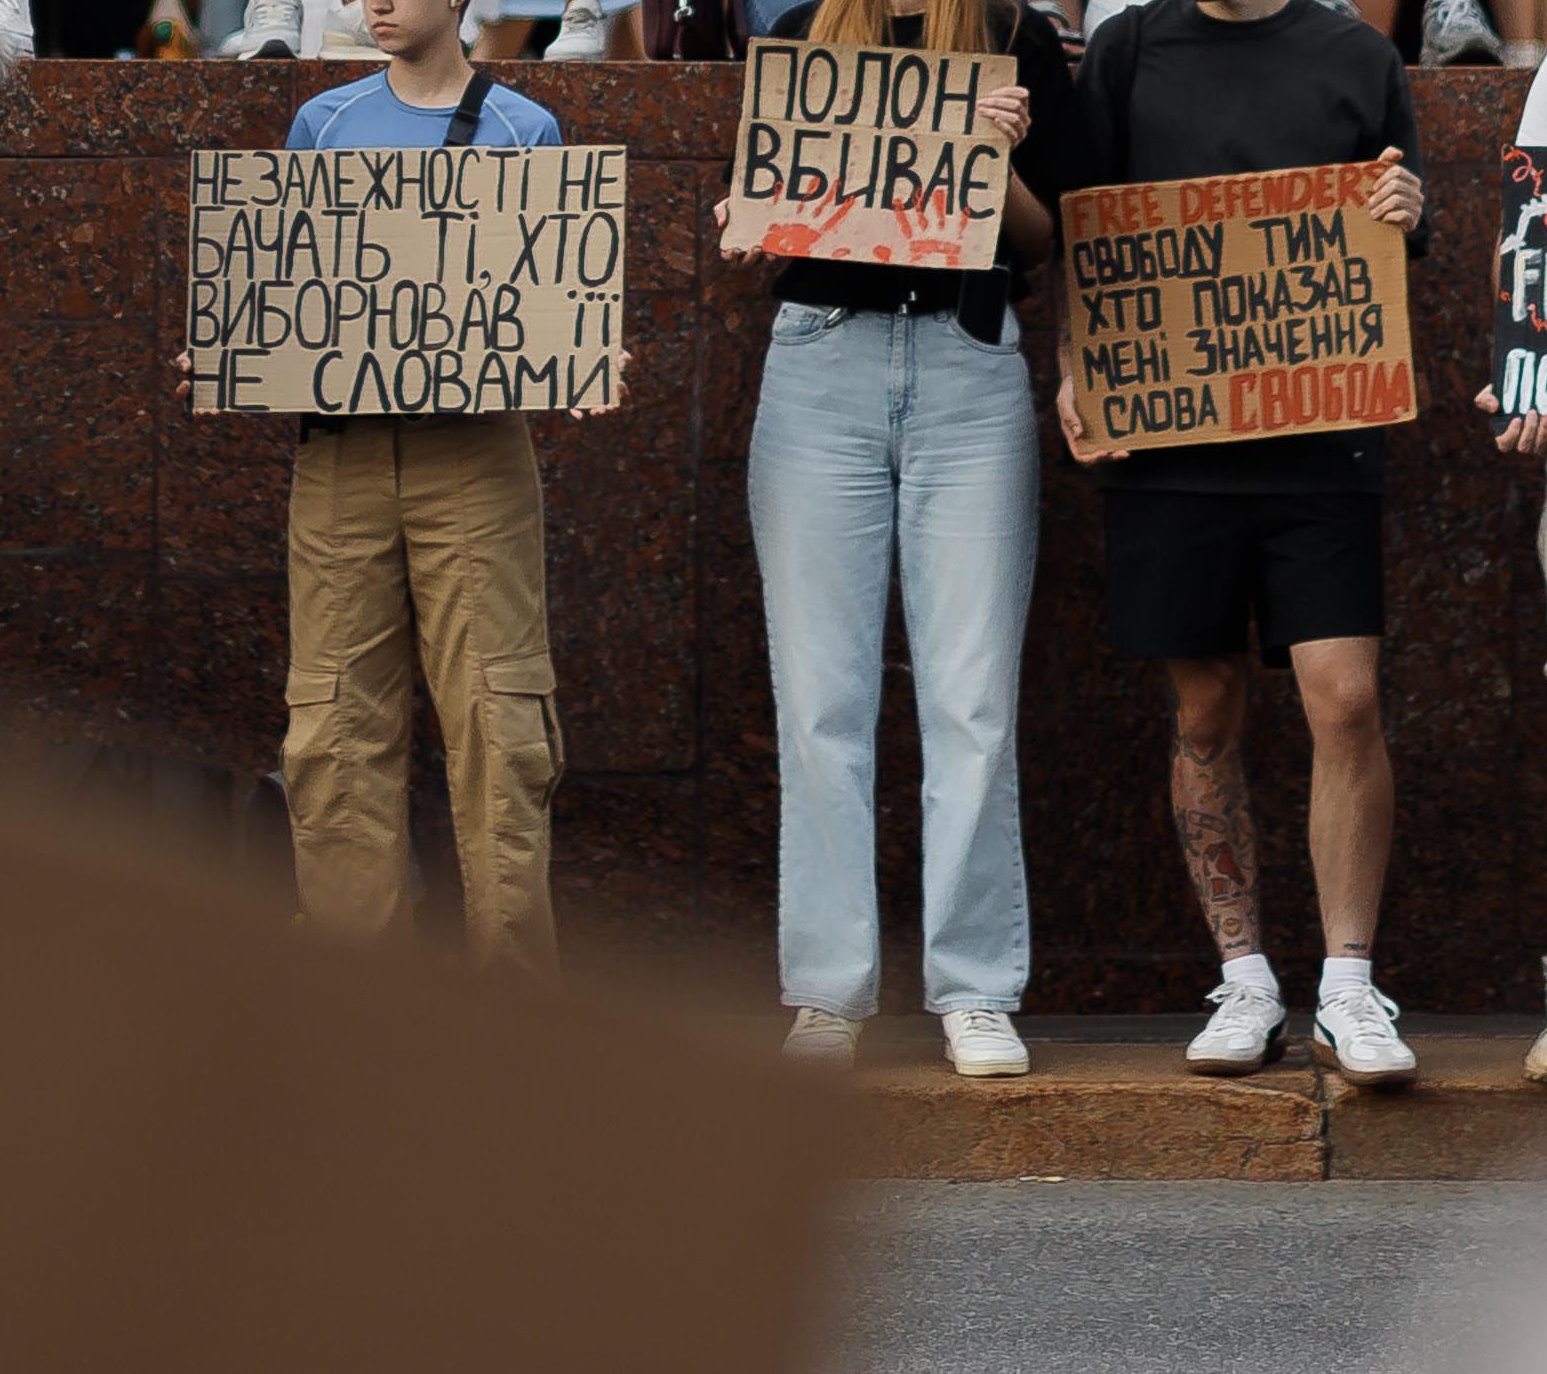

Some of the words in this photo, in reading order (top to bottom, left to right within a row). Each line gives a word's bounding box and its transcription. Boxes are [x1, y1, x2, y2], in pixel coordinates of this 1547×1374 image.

[752, 45, 982, 135] ПОЛОН
[559, 149, 624, 212] НЕ
[743, 122, 1000, 220] ВБИВАЄ
[192, 207, 392, 283] БАЧАТЬ
[509, 211, 621, 287] ХТО
[1070, 185, 1164, 238] FREE
[1072, 221, 1224, 288] СВОБОДУ
[1249, 208, 1348, 267] ТИМ
[189, 279, 525, 352] ВИБОРЮВАВ
[1081, 285, 1162, 336] ХТО
[1192, 256, 1372, 327] ПОКАЗАВ
[1187, 304, 1385, 376] ЗНАЧЕННЯ
[187, 347, 271, 411] НЕ
[312, 350, 611, 414] СЛОВАМИ
[1104, 384, 1219, 439] СЛОВА
[1228, 358, 1410, 434] СВОБОДА
